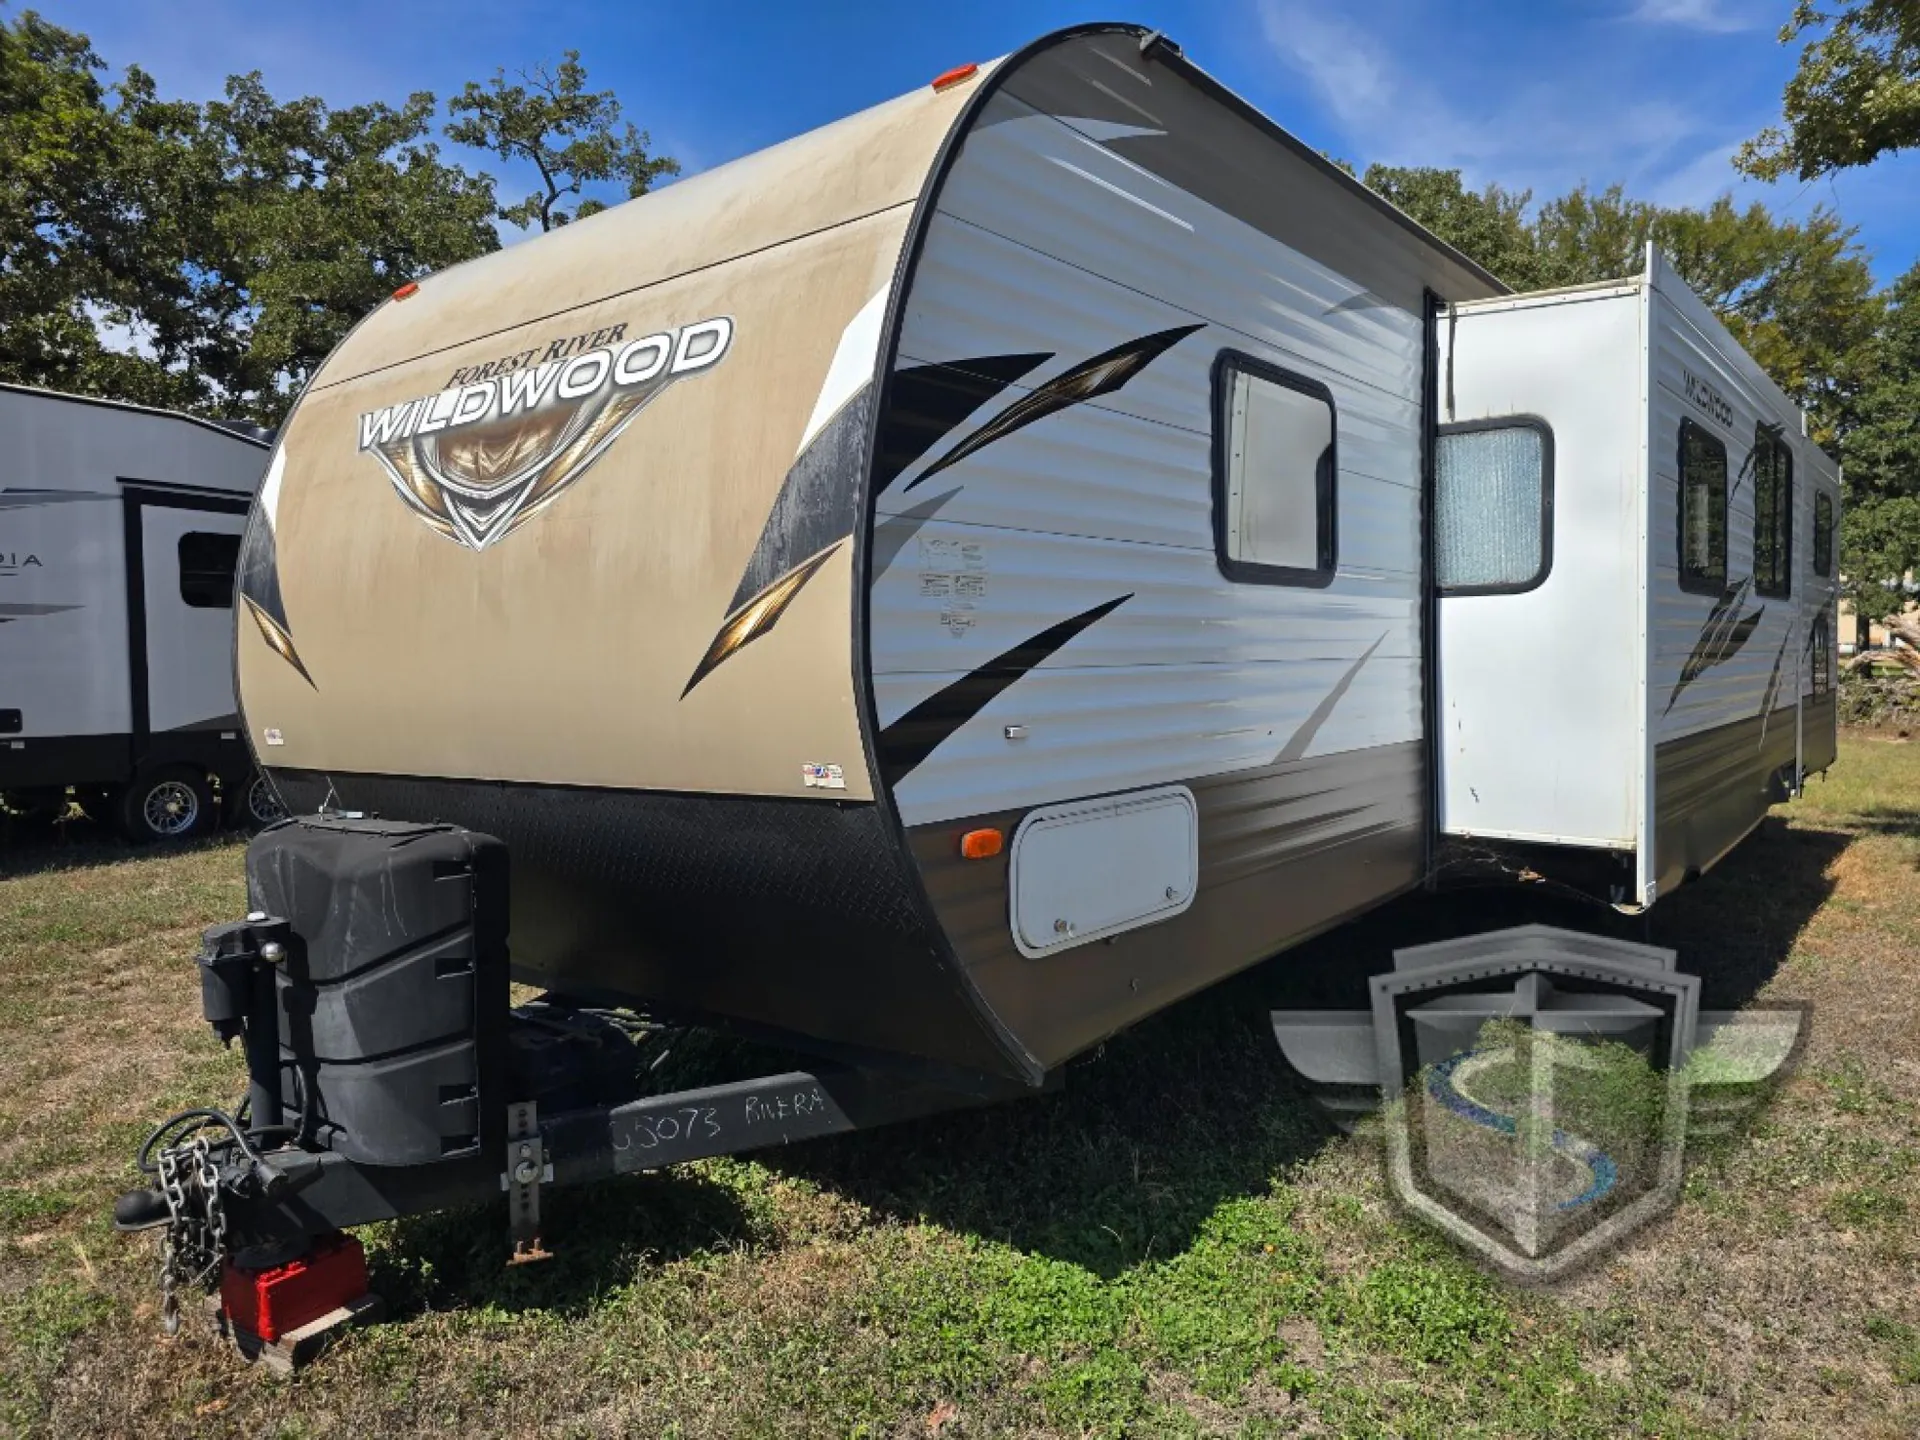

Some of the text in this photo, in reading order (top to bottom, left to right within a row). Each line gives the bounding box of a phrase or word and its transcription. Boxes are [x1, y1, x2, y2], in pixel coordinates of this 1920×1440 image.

[360, 316, 734, 450] WILDWOOD
[443, 321, 629, 390] FOREST RIVER
[1682, 368, 1733, 428] WILDWOOD
